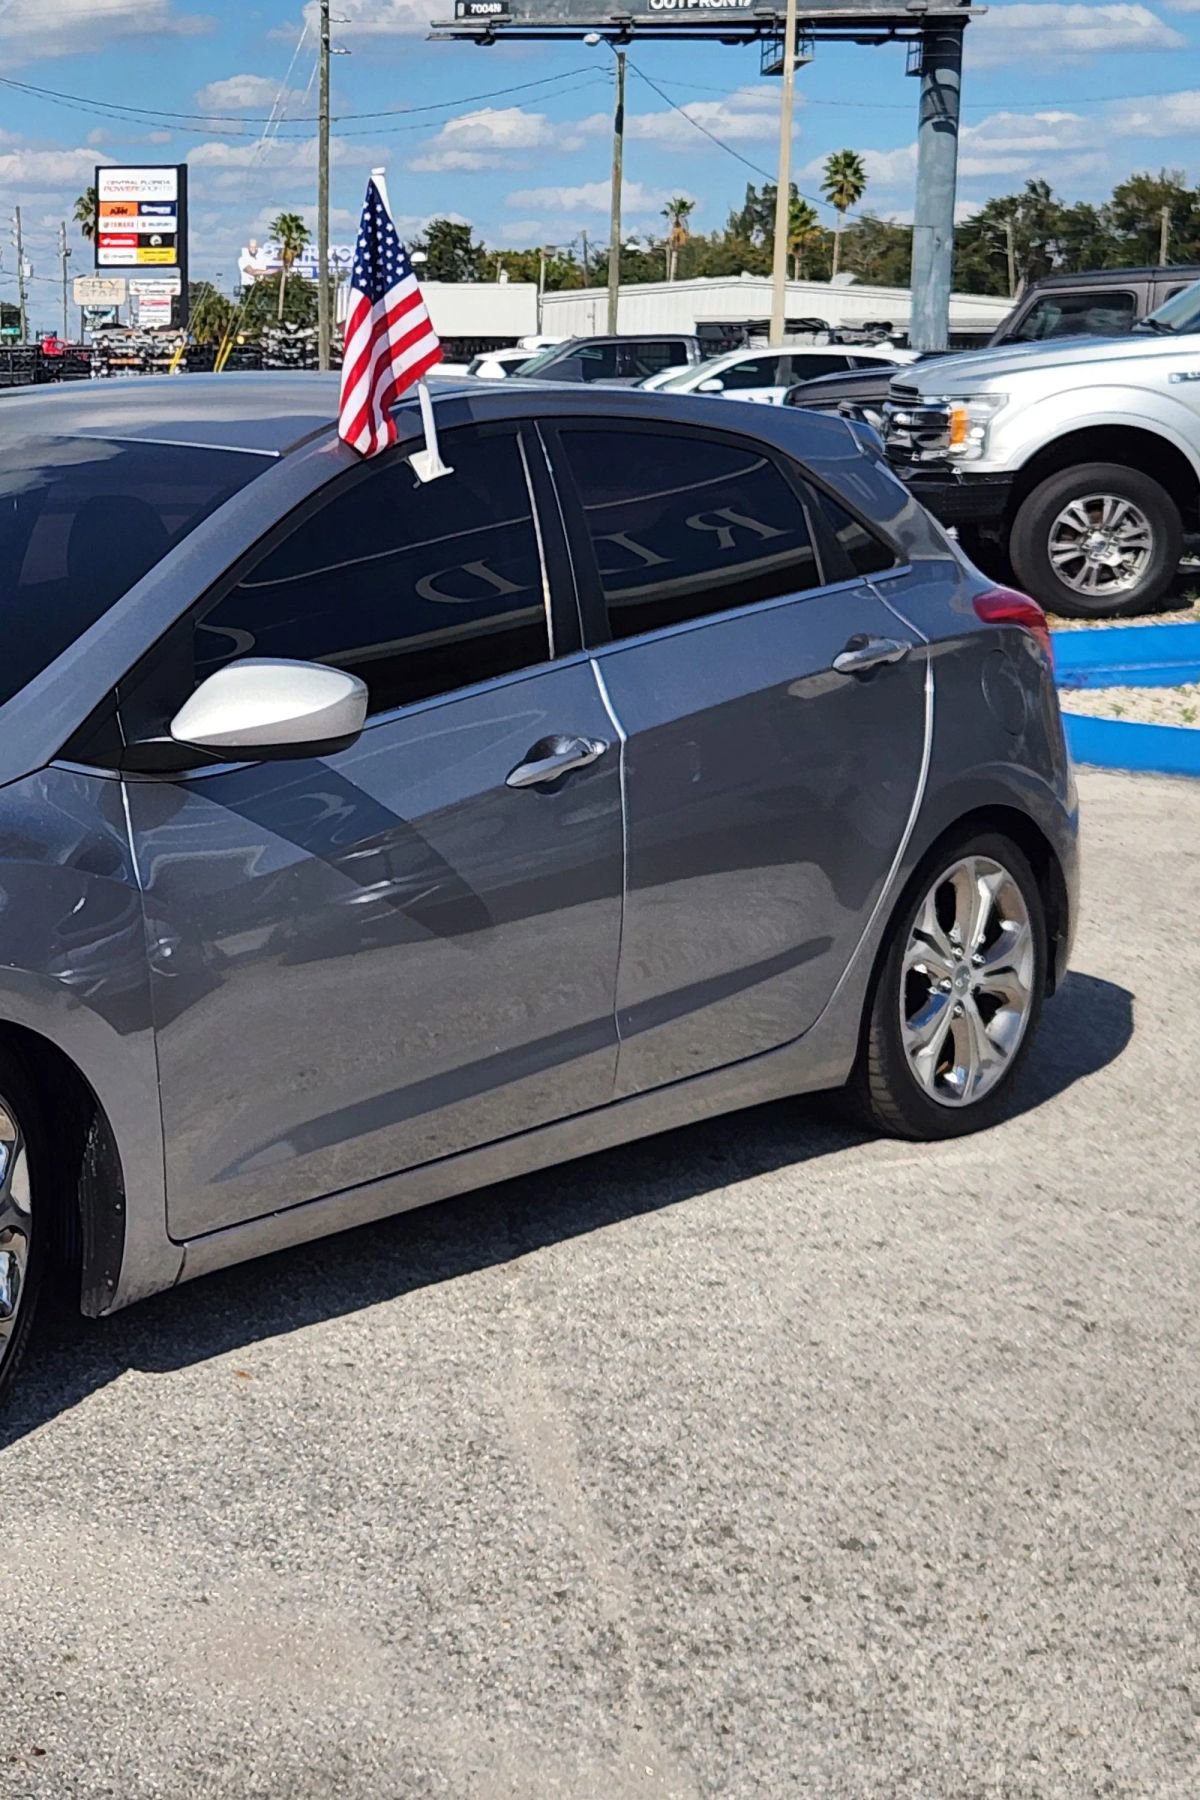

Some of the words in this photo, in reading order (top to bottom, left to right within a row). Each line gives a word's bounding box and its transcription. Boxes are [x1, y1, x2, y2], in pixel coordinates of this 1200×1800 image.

[470, 3, 502, 14] 7004N
[110, 206, 129, 215] KTM
[80, 281, 120, 289] CITY
